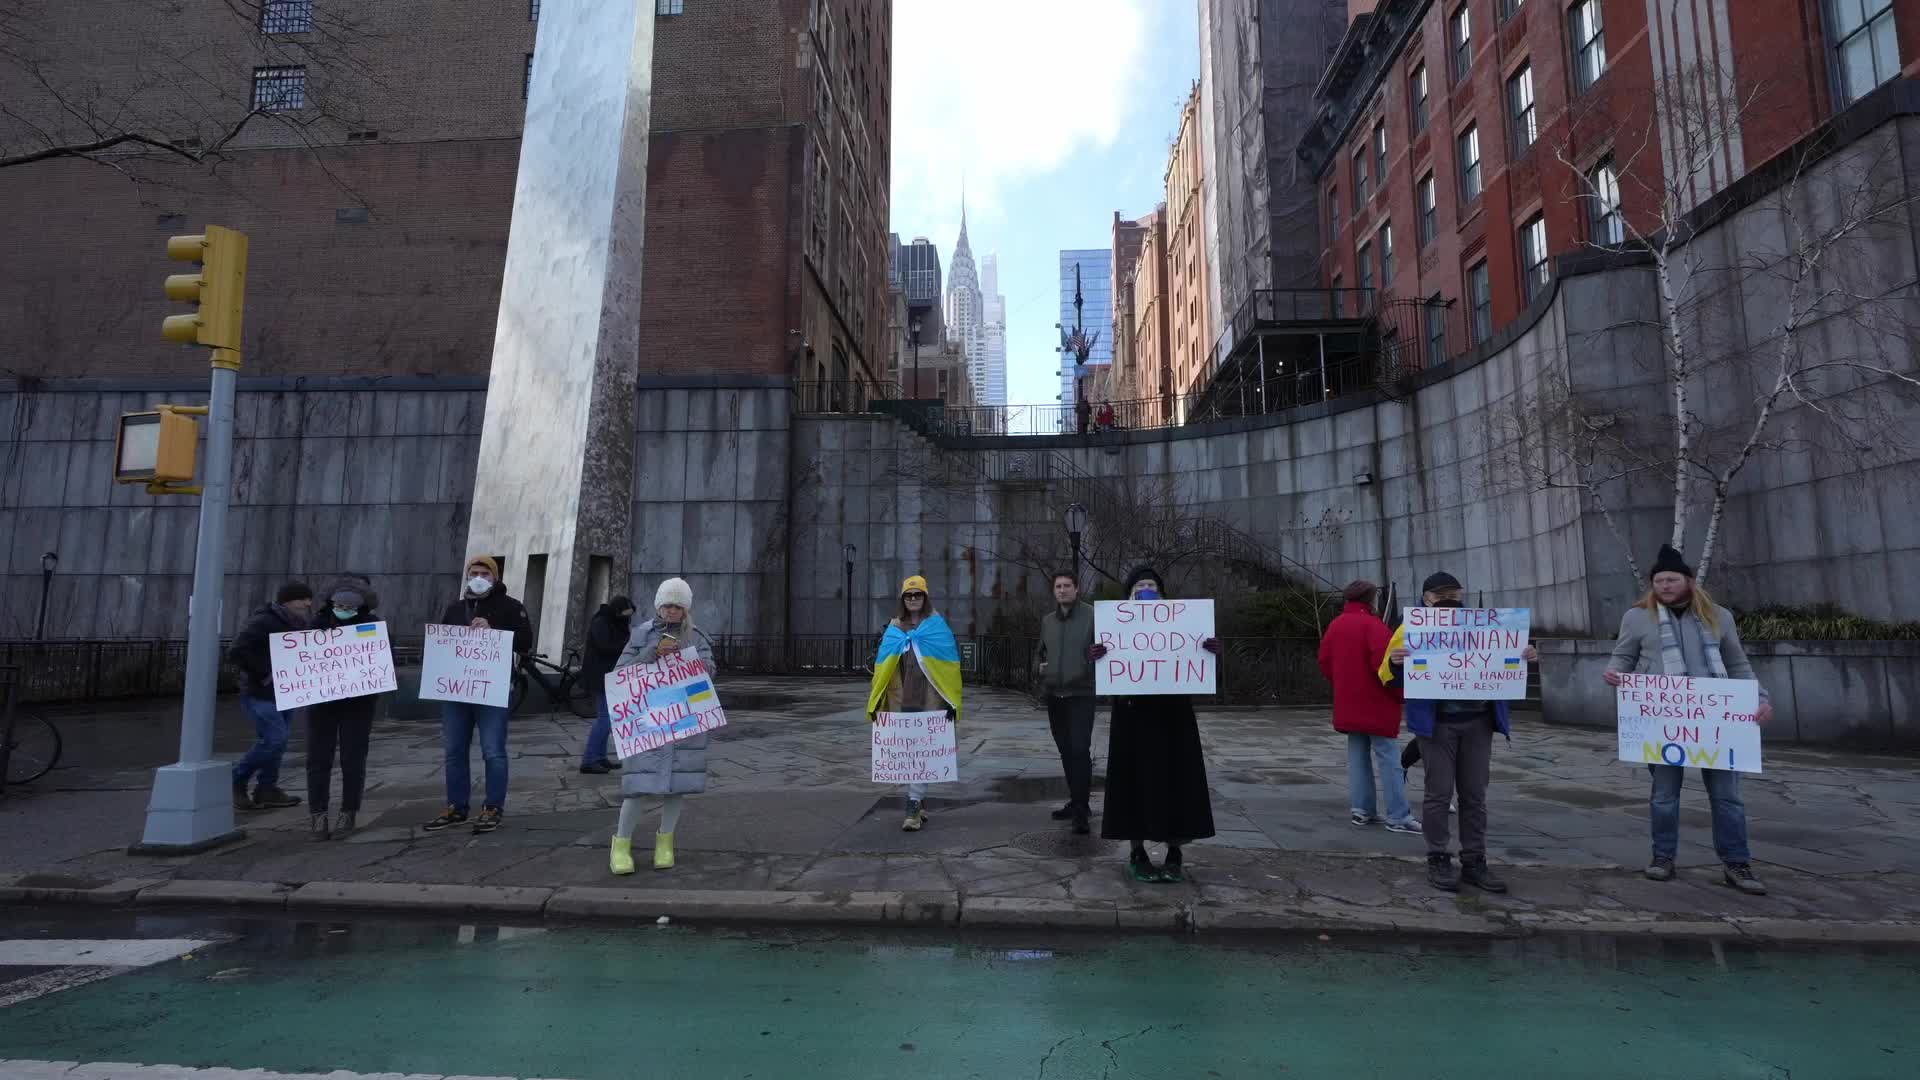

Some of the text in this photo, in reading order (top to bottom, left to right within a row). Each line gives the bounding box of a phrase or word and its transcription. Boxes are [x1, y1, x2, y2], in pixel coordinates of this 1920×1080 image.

[1117, 603, 1185, 623] STOP
[1410, 608, 1500, 626] SHELTER
[283, 628, 344, 649] STOP
[1100, 632, 1204, 652] BLOODY
[299, 640, 387, 663] BLOODSHED
[456, 646, 500, 662] RUSSIA
[1448, 653, 1491, 668] SKY
[296, 653, 376, 677] UKRAINE
[464, 665, 488, 677] from
[616, 651, 685, 684] SHELTER
[280, 664, 388, 694] SHELTER SKY
[1408, 671, 1525, 680] WE WILL HANDLE
[1622, 674, 1696, 690] REMOVE
[436, 677, 492, 698] SWIFT
[1441, 682, 1464, 690] THE
[1620, 691, 1734, 707] TERRORIST
[616, 702, 694, 740] WE WILL
[1640, 704, 1705, 720] RUSSIA
[622, 722, 680, 757] HANDLE
[874, 731, 936, 750] Budapest
[1663, 725, 1699, 744] UN
[1643, 740, 1720, 767] NOW
